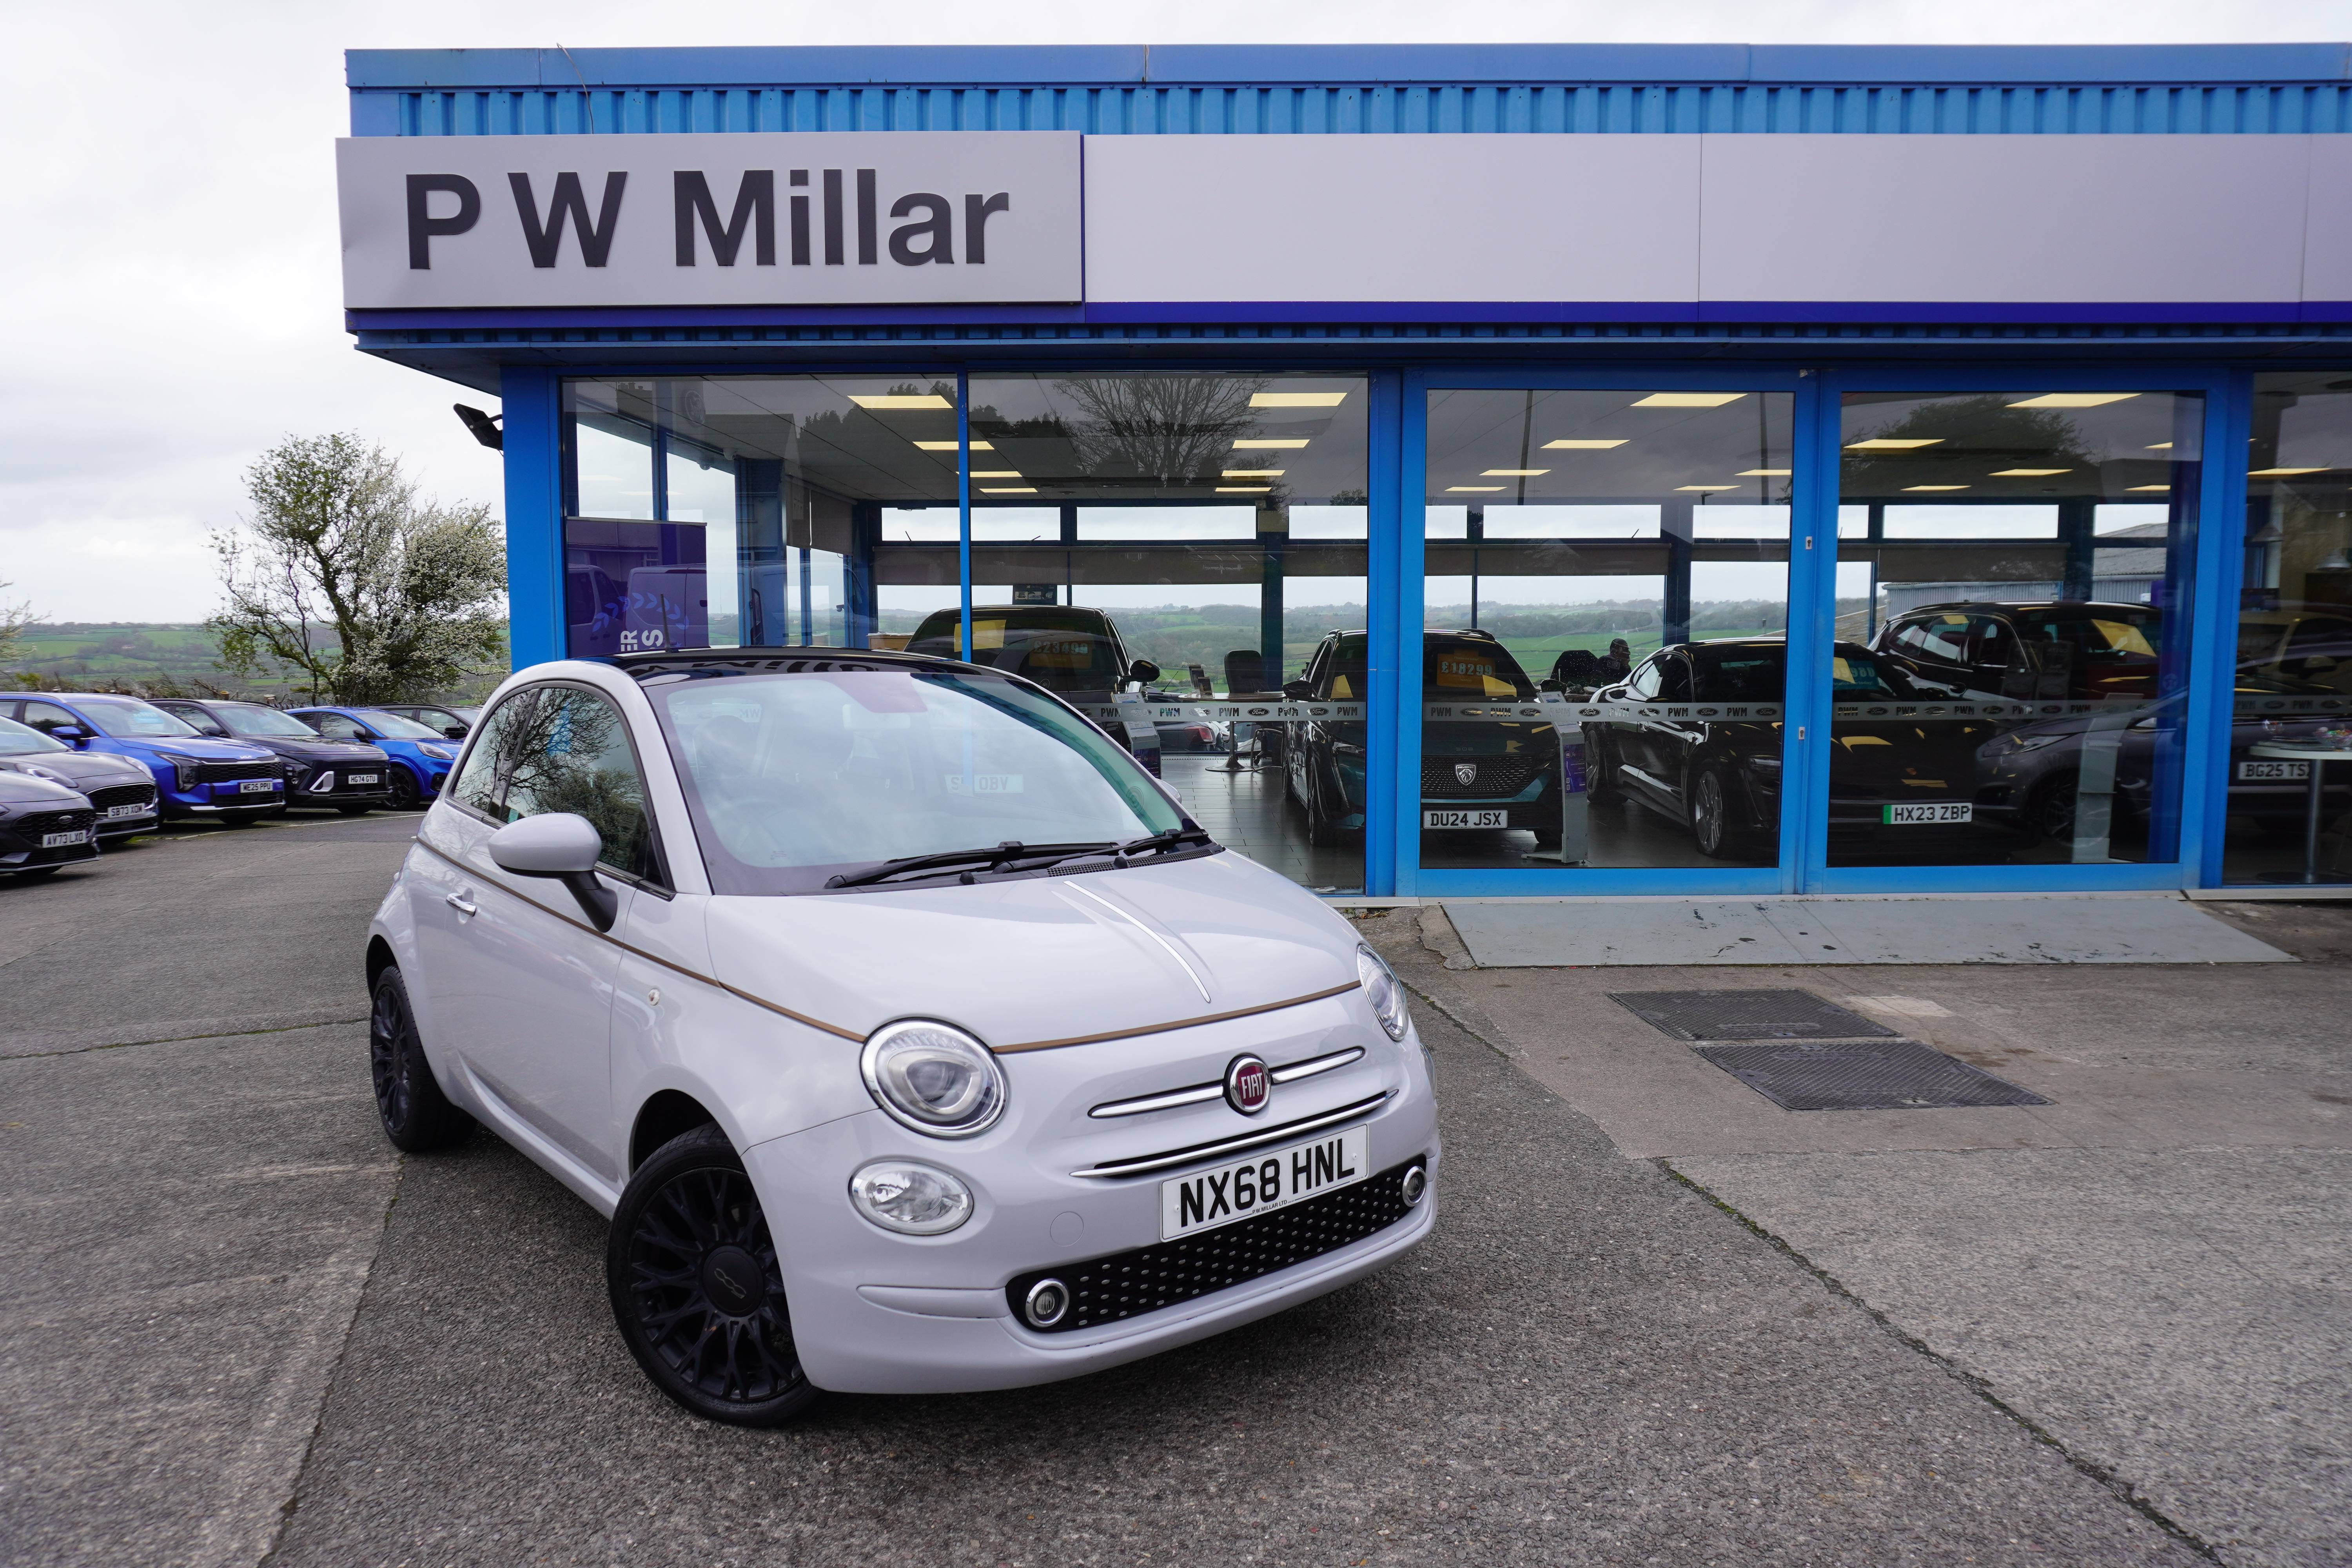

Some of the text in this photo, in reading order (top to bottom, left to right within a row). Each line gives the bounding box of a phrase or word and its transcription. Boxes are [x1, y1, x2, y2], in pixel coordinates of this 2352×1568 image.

[406, 169, 1009, 270] P W Millar
[1441, 661, 1492, 676] £18299
[1160, 708, 1180, 717] PWM
[1219, 707, 1239, 717] PWM
[1278, 707, 1298, 717] PWM
[1338, 706, 1358, 716] PWM
[1431, 707, 1451, 717] PWM
[1490, 707, 1511, 717] PWM
[1668, 707, 1688, 717] PWM
[1727, 707, 1748, 717] PWM
[1838, 706, 1858, 716] PWM
[1896, 706, 1916, 716] PWM
[1955, 706, 1975, 715] PWM
[2245, 764, 2309, 777] BG25 TS
[111, 806, 129, 816] SB73
[1895, 806, 1970, 821] HX23 ZBP
[1430, 812, 1501, 826] DU24 JSX
[1241, 1072, 1263, 1099] FIAT
[1180, 1138, 1356, 1228] NX68 HNL
